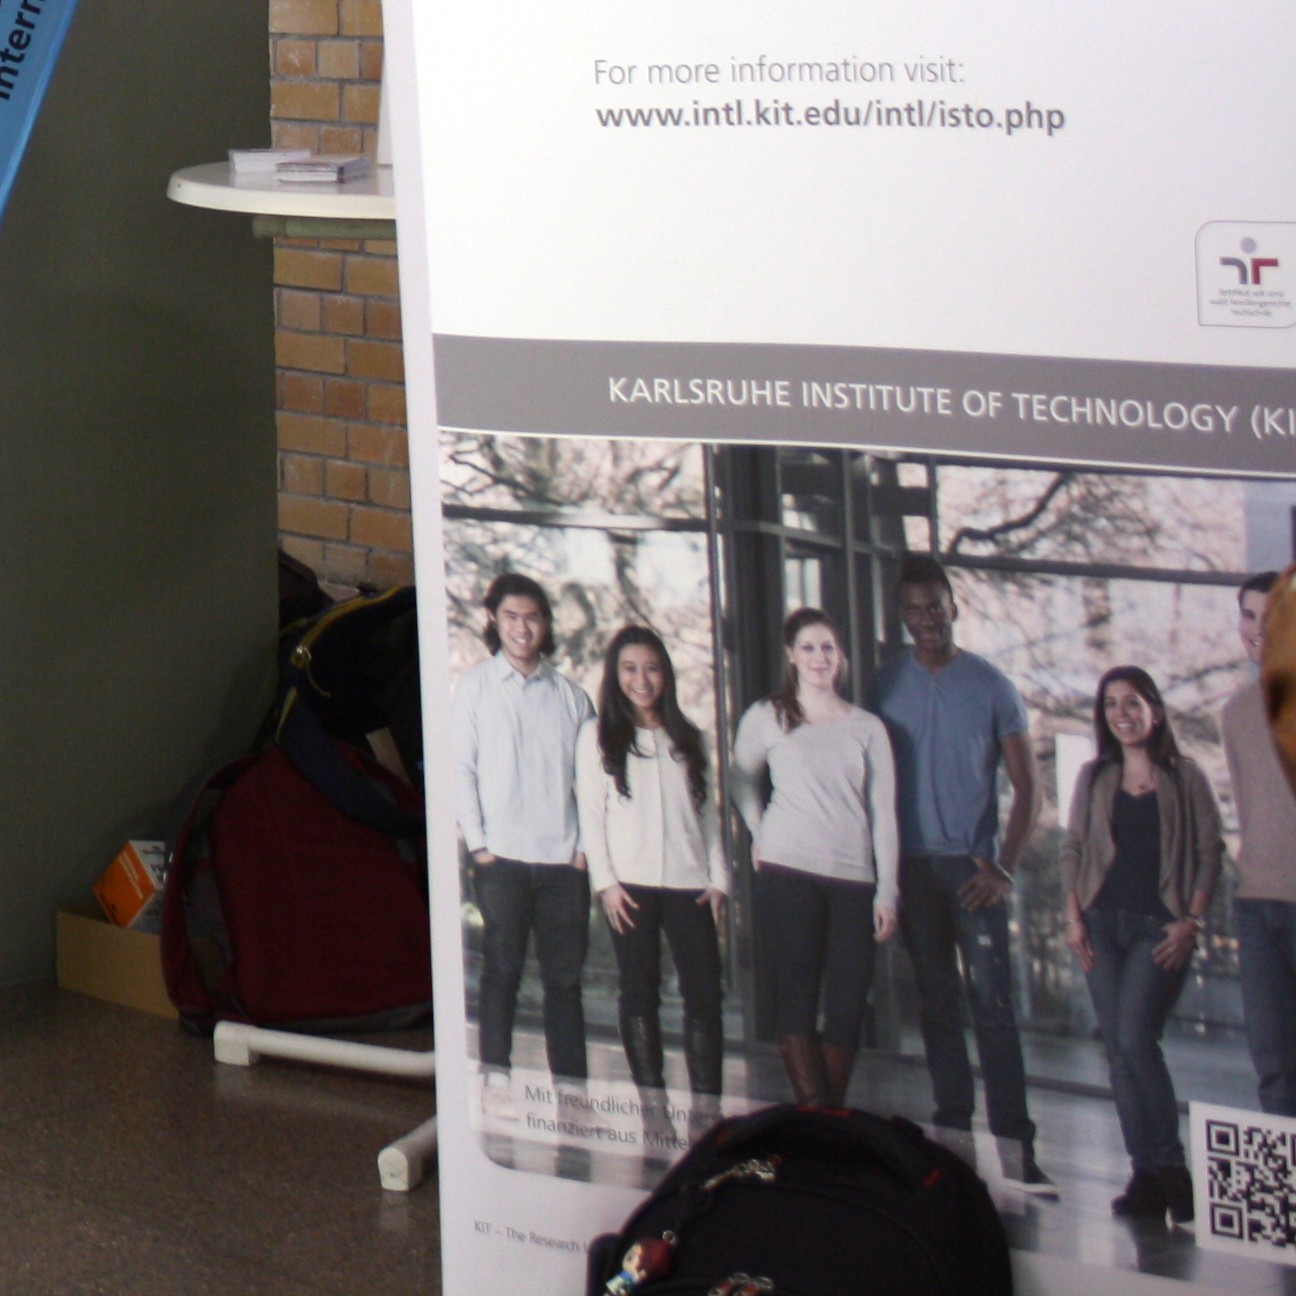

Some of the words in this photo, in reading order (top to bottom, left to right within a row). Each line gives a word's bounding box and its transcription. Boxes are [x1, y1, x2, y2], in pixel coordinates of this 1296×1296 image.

[593, 58, 638, 86] For
[646, 58, 721, 86] more
[729, 54, 896, 85] information
[902, 54, 967, 85] visit:
[595, 97, 1067, 137] www.intl.kit.edu/intl/isto.php
[607, 376, 791, 408] KARLSRUHE
[801, 381, 953, 416] INSTITUTE
[961, 389, 1004, 418] OF
[1011, 392, 1239, 434] TECHNOLOGY
[524, 1084, 552, 1105] Mit
[525, 1112, 606, 1141] finanziert
[608, 1129, 637, 1145] aus
[642, 1132, 690, 1151] Mitte
[473, 1220, 493, 1235] KIT
[505, 1226, 527, 1243] The
[529, 1232, 580, 1253] Research
